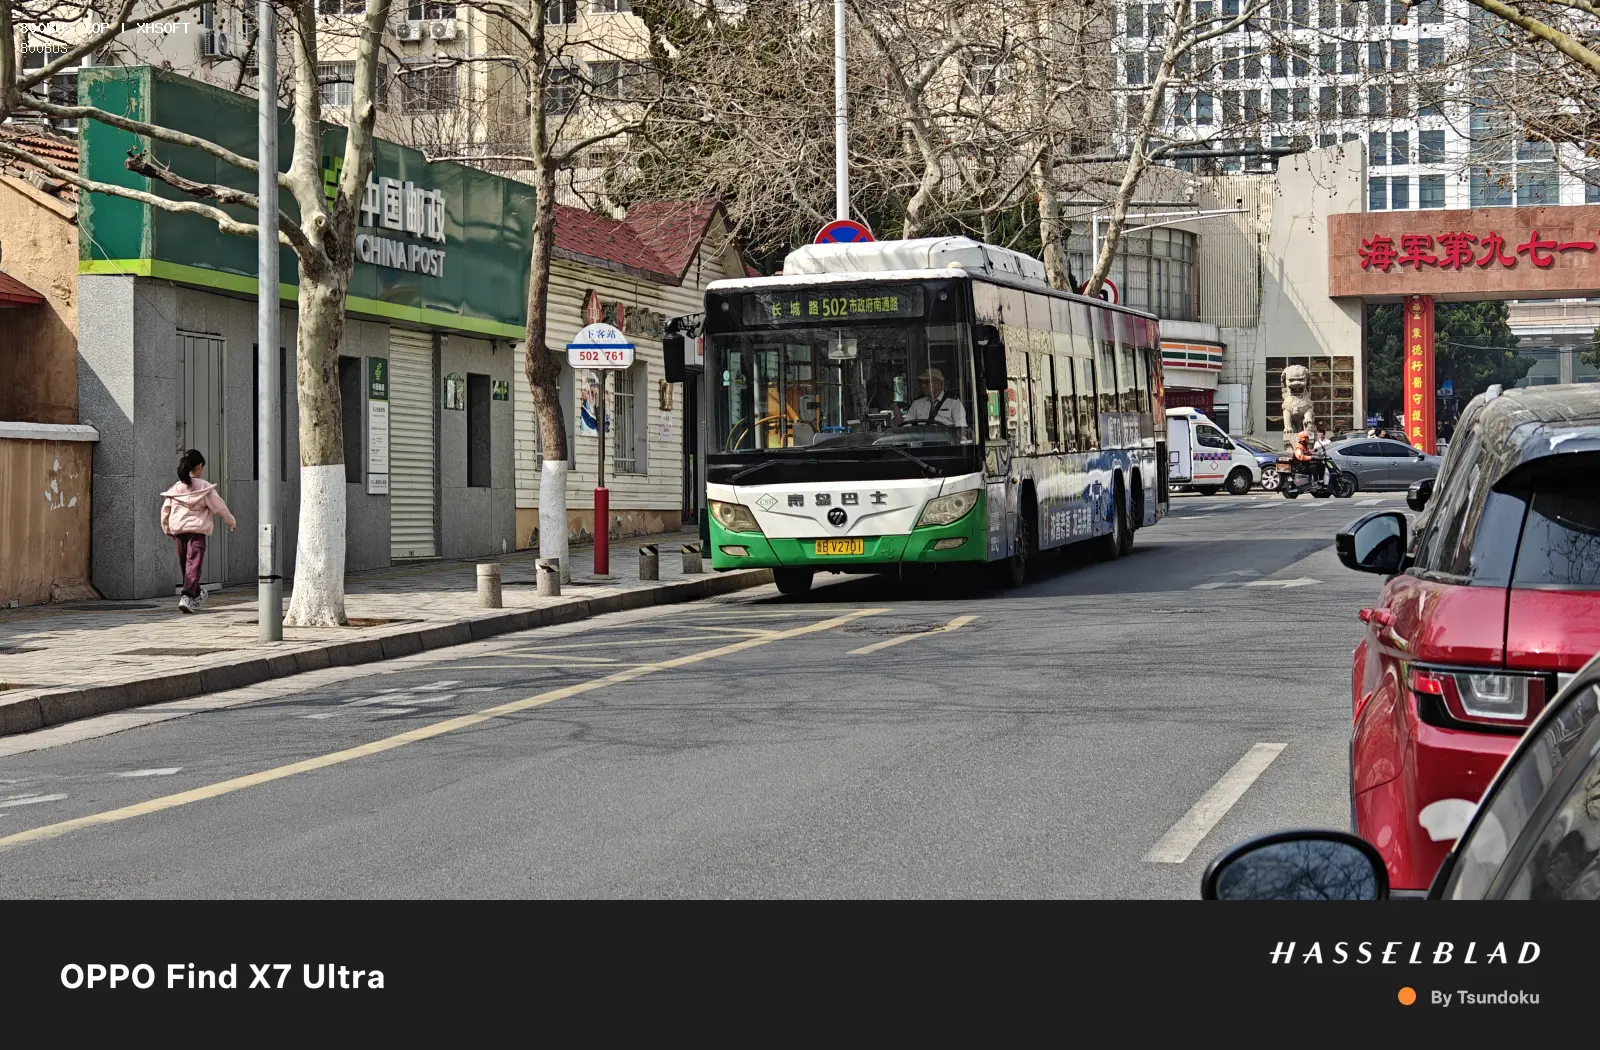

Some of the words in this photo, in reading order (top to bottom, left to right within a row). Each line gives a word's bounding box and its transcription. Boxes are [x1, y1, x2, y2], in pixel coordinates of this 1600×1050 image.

[361, 171, 446, 244] 中国邮政
[356, 233, 407, 270] CHINA
[408, 244, 446, 278] POST
[1358, 231, 1600, 271] 海军第九七一
[822, 297, 848, 317] 502
[587, 329, 616, 339] 下客站
[579, 351, 599, 361] 502
[604, 351, 624, 361] 761
[787, 490, 888, 508] 青岛巴士
